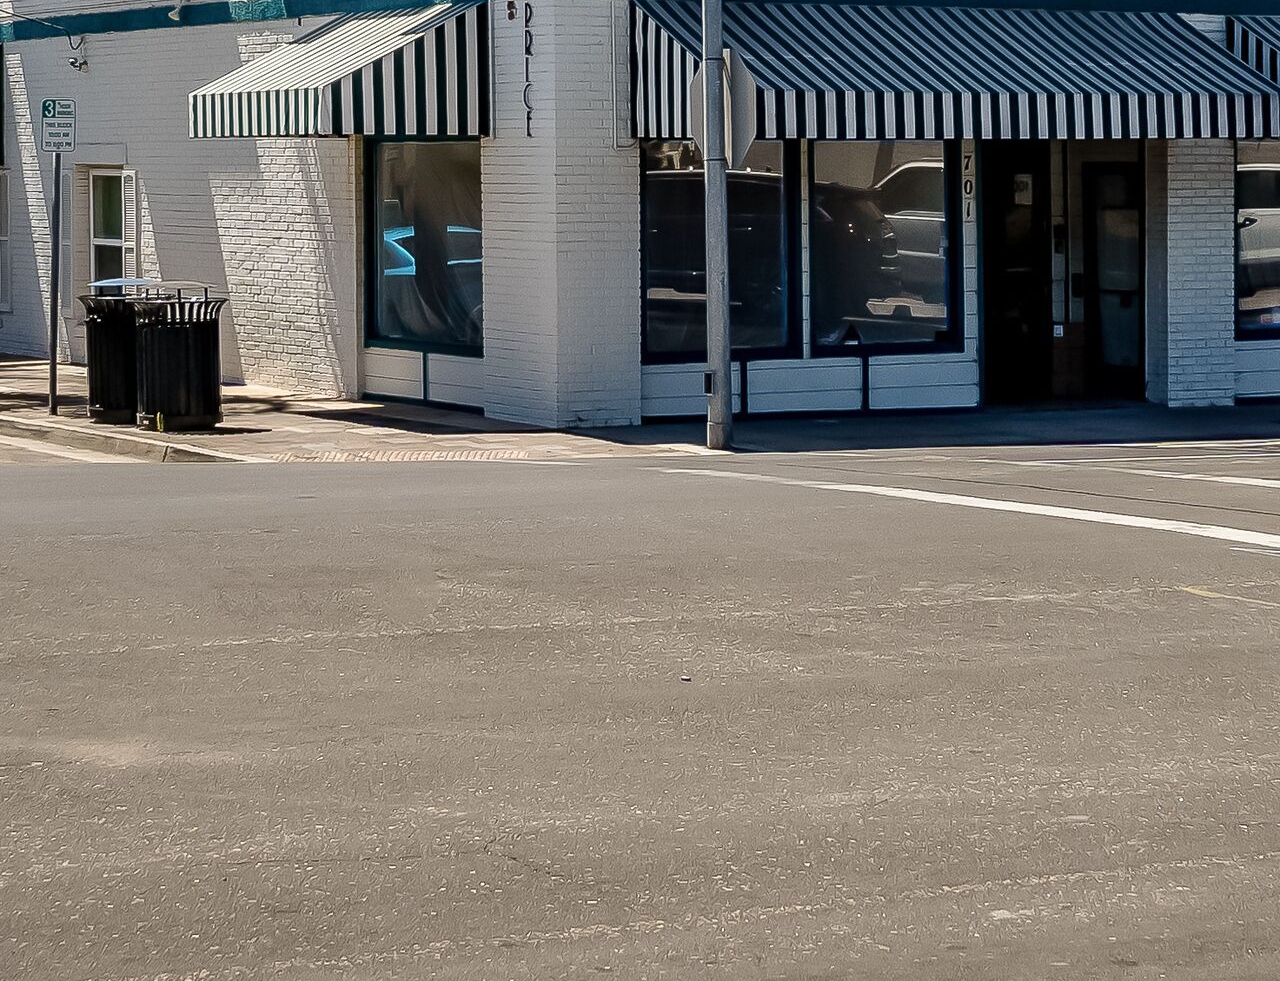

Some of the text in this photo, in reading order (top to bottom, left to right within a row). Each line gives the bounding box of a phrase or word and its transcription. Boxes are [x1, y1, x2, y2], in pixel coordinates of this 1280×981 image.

[523, 2, 535, 138] PRICE
[45, 101, 54, 117] 3
[964, 155, 973, 218] 701
